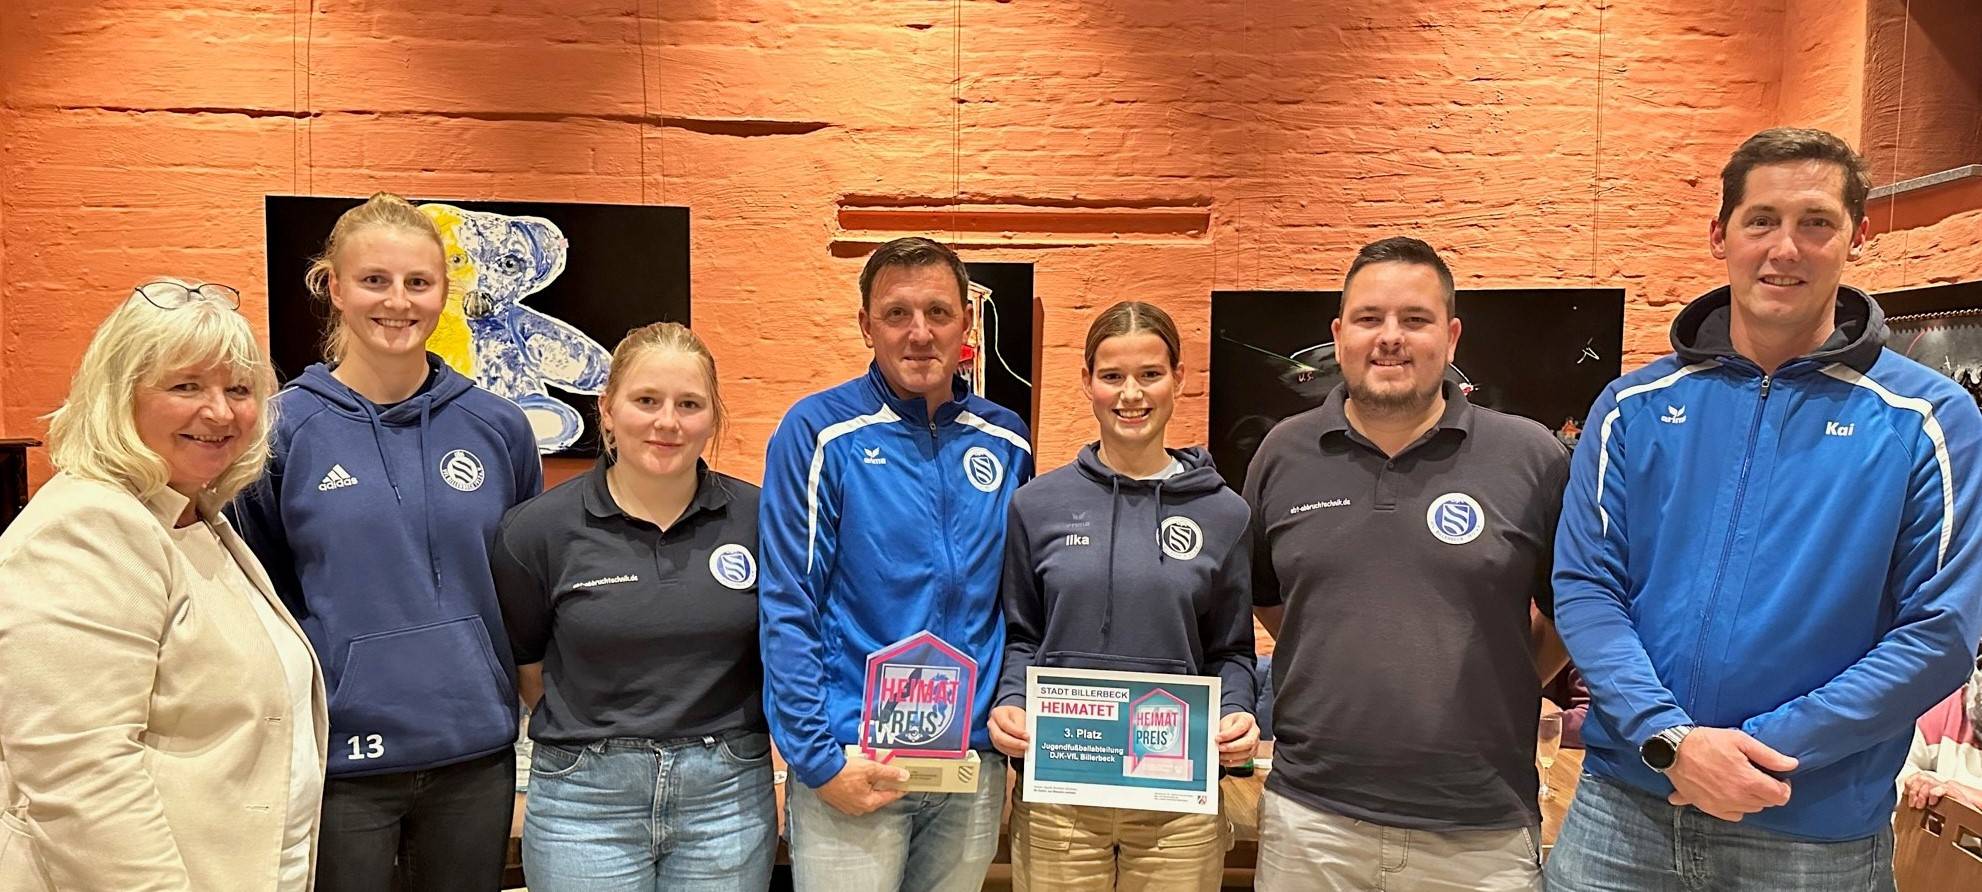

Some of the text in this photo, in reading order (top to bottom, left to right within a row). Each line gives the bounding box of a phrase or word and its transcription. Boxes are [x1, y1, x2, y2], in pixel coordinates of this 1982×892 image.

[1825, 421, 1854, 436] Kai
[318, 477, 358, 491] adidas
[1065, 534, 1090, 546] Ilka
[881, 677, 960, 705] HEIMAT
[1040, 686, 1128, 699] STADT BILLERBECK
[1041, 701, 1115, 717] HEIMATET
[878, 709, 938, 735] PREIS
[1136, 711, 1178, 727] HEIMAT
[1064, 727, 1103, 740] 3. Platz
[1136, 730, 1168, 746] PREIS
[347, 734, 385, 760] 13
[1080, 754, 1116, 763] Billerbeck
